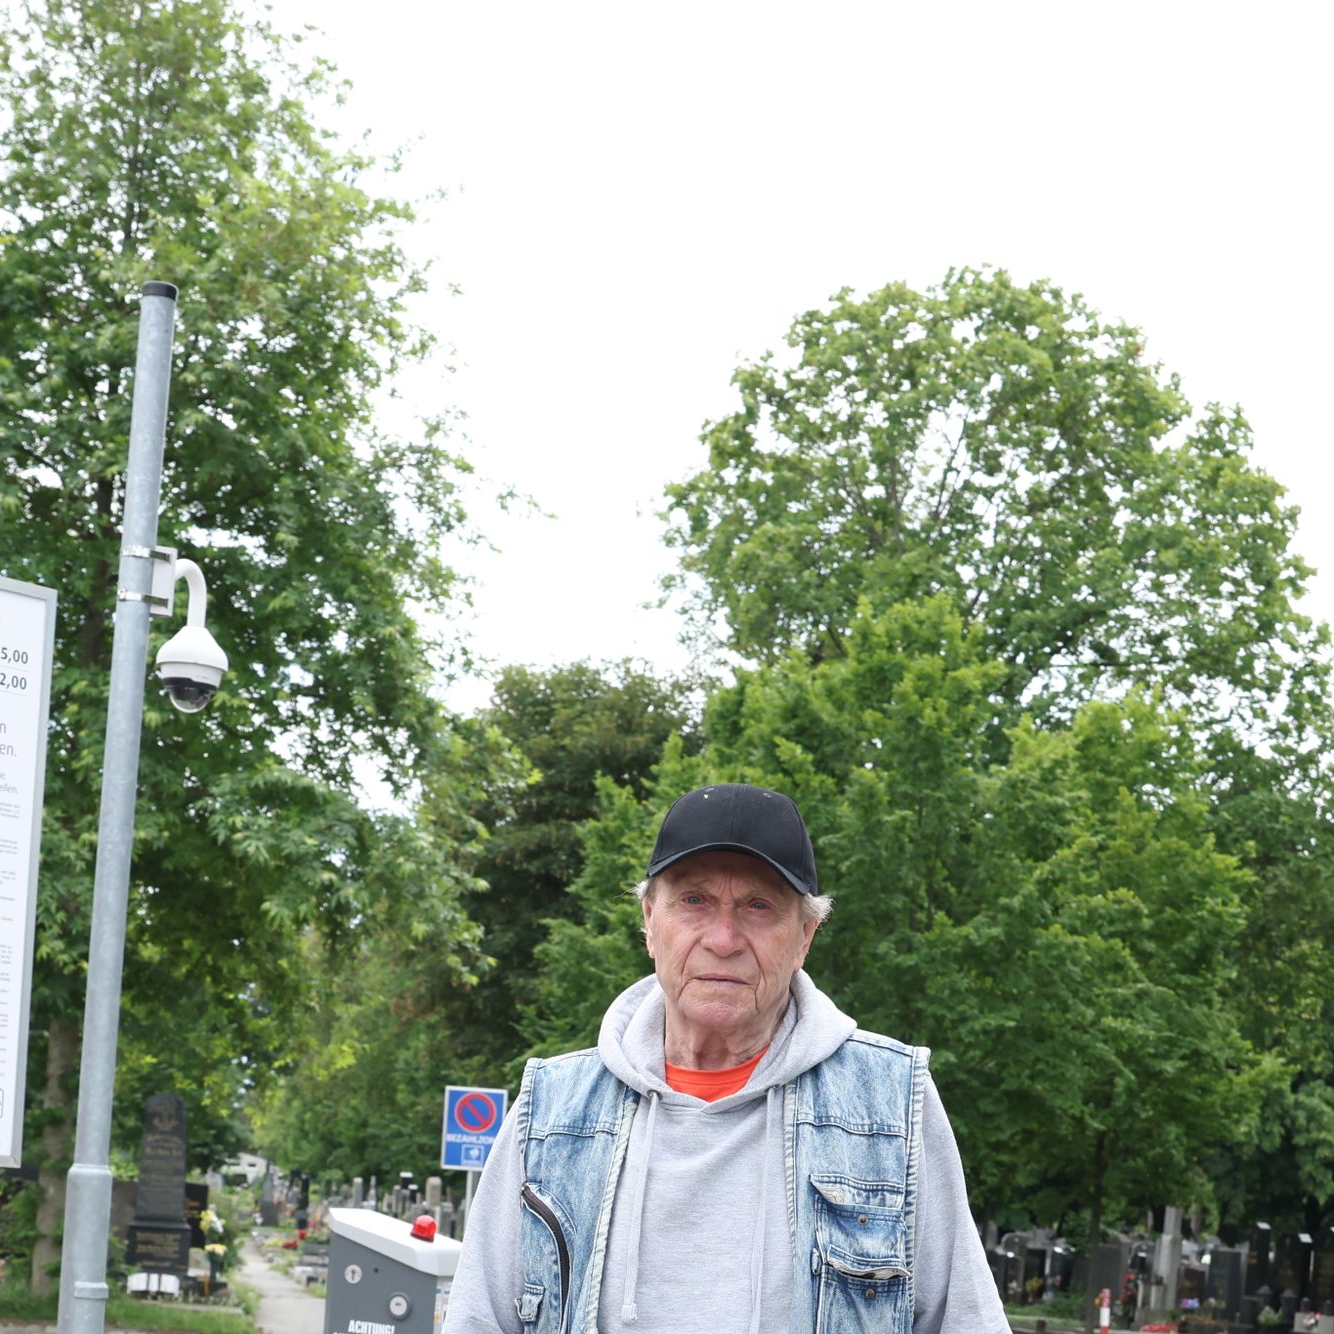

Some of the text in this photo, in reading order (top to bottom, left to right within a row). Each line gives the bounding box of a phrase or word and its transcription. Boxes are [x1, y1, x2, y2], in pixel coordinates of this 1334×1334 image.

[0, 647, 28, 665] 5,00
[0, 672, 27, 690] 2,00
[446, 1133, 496, 1144] BEZAHLZON
